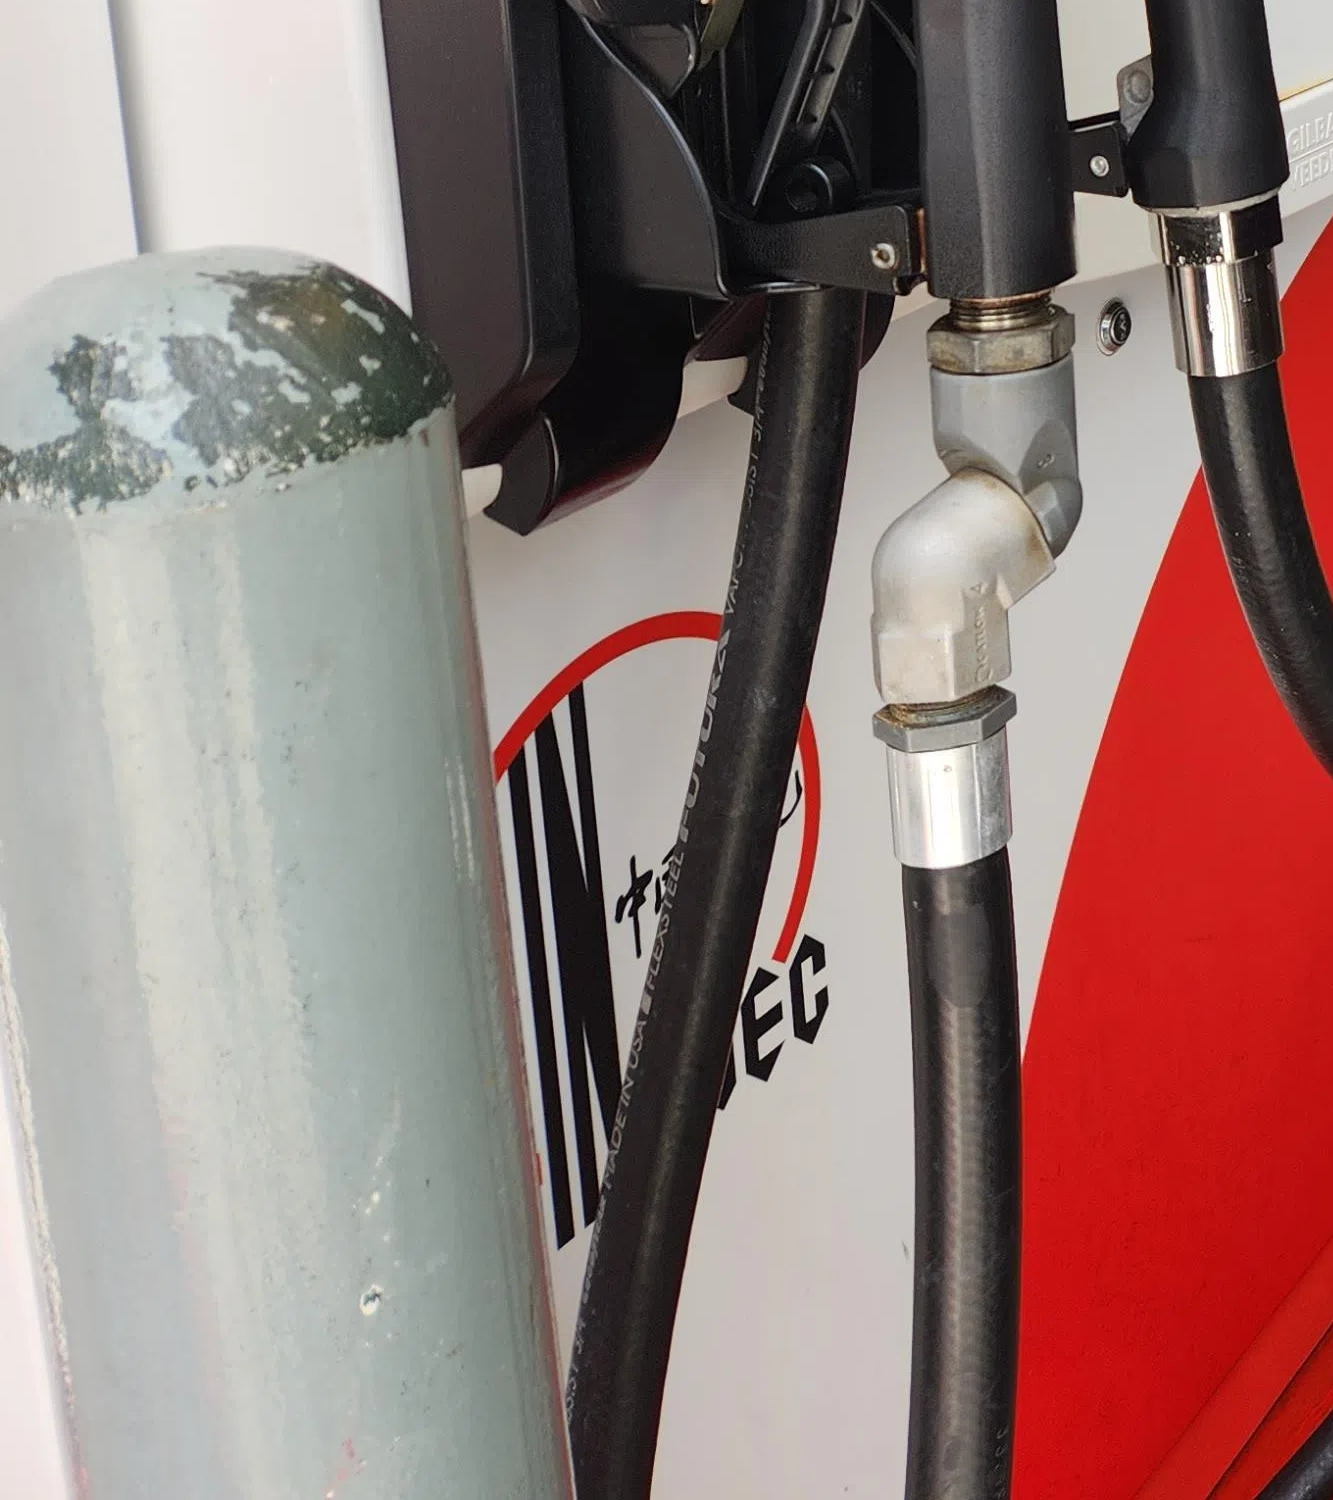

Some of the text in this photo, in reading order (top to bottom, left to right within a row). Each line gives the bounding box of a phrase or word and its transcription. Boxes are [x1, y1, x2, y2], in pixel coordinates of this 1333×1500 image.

[604, 1108, 630, 1191] MADE
[619, 1077, 635, 1107] IN
[630, 1018, 648, 1070] USA
[646, 850, 685, 992] FLEXSTEEL
